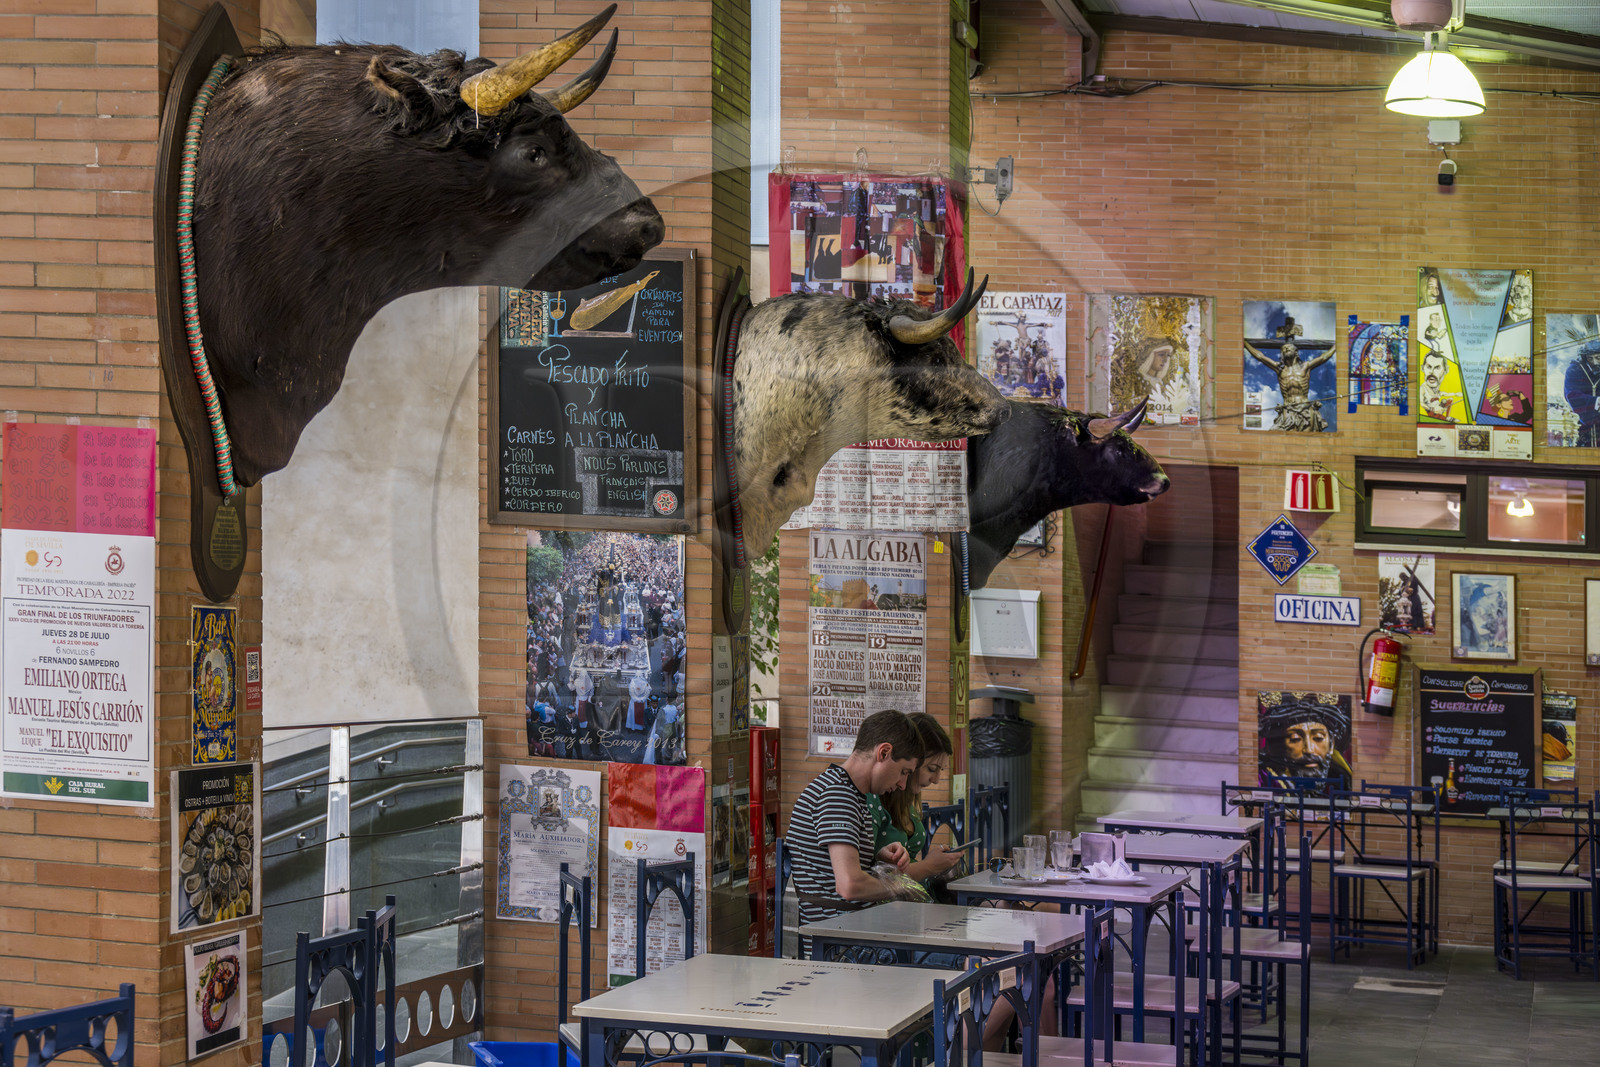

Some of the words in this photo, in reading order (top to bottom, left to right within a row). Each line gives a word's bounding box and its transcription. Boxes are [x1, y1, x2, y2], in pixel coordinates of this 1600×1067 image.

[980, 296, 999, 309] EL
[508, 289, 519, 329] UENA
[520, 289, 531, 345] AMENTE
[531, 290, 543, 345] XAGERA
[646, 316, 671, 326] PARA
[537, 344, 609, 386] PESCADO
[1148, 403, 1174, 413] 2014
[564, 403, 627, 429] PLANCHA
[507, 426, 556, 445] CARNES
[565, 431, 575, 447] A
[579, 432, 594, 447] LA
[596, 430, 660, 450] PLANCHA
[510, 463, 555, 475] TERNERA
[583, 454, 617, 472] NOUS
[619, 454, 668, 475] PARLONS
[511, 476, 537, 486] BUEY
[511, 487, 543, 498] CERDO
[607, 489, 648, 501] ENGLISH
[509, 499, 563, 512] CORDERO
[813, 537, 839, 560] LA
[841, 539, 923, 564] ALGABA
[17, 584, 104, 599] TEMPORADA
[107, 589, 135, 601] 2022
[1279, 597, 1356, 622] OFICINA
[17, 609, 36, 618] GRAN
[37, 610, 57, 619] FINAL
[59, 611, 67, 619] DE
[69, 612, 82, 620] LOS
[84, 613, 135, 623] TRIUNFADORES
[204, 613, 227, 642] Bar
[42, 629, 67, 638] JUEVES
[69, 630, 78, 639] 28
[80, 631, 89, 639] DE
[90, 631, 110, 640] JULIO
[813, 634, 830, 646] 18
[870, 637, 886, 648] 19
[56, 646, 61, 654] 6
[62, 648, 89, 656] NOVILLOS
[90, 648, 96, 656] 6
[813, 649, 836, 660] JUAN
[38, 656, 78, 667] FERNANDO
[79, 658, 120, 669] SAMPEDRO
[869, 652, 885, 662] JUAN
[886, 653, 922, 663] CORBACHO
[836, 660, 865, 672] ROMERO
[869, 662, 892, 672] DAVID
[24, 667, 80, 689] EMILIANO
[82, 671, 128, 693] ORTEGA
[826, 670, 849, 681] ANTONIO
[869, 671, 886, 680] JUAN
[813, 685, 831, 696] 20
[894, 682, 921, 693] GRANDE
[7, 696, 55, 718] MANUEL
[56, 696, 91, 721] JESÚS
[92, 699, 144, 724] CARRIÓN
[813, 699, 840, 708] MANUEL
[841, 700, 865, 709] TRIANA
[813, 707, 831, 716] DANIEL
[832, 708, 839, 716] DE
[839, 709, 846, 717] LA
[846, 709, 866, 718] FUENTE
[813, 716, 831, 725] LUIS
[18, 727, 45, 738] MANUEL
[813, 725, 835, 734] RAFAEL
[21, 737, 43, 748] LUQUE
[538, 726, 576, 750] Cruz
[578, 732, 594, 745] de
[597, 729, 642, 753] Carey
[641, 736, 679, 750] 2013
[68, 780, 84, 789] CAJA
[84, 781, 106, 790] RURAL
[202, 776, 230, 791] PROMOCIÓN
[69, 786, 82, 795] DEL
[83, 787, 97, 796] SUR
[184, 797, 202, 808] OSTRAS
[205, 796, 224, 806] BOTELLA
[513, 830, 537, 840] MARÍA
[540, 834, 586, 844] AUXILIADORA
